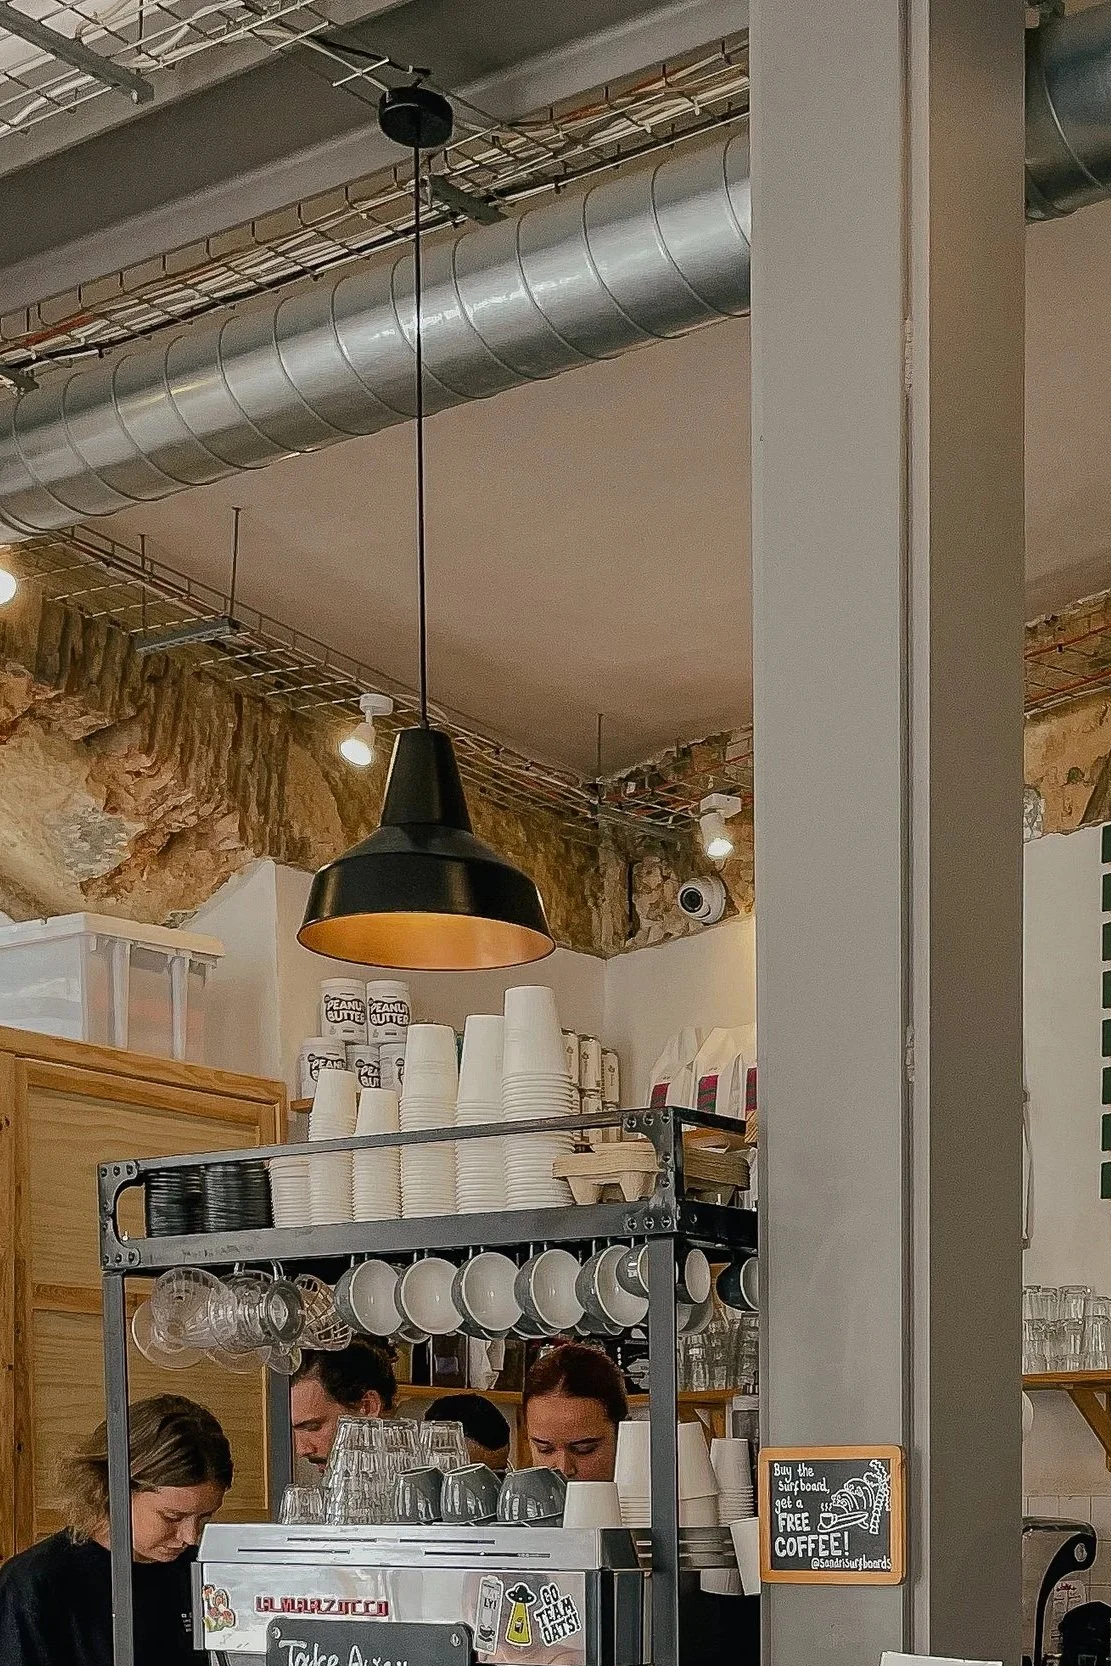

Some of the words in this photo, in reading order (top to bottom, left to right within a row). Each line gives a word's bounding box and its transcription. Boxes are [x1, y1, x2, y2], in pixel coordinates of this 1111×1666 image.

[774, 1463, 792, 1482] Buy
[797, 1463, 815, 1477] the
[775, 1495, 793, 1515] get
[796, 1499, 804, 1508] a
[778, 1512, 811, 1533] FREE
[774, 1531, 850, 1557] COFFEE!
[541, 1584, 559, 1606] GO
[536, 1596, 575, 1628] TEAM
[543, 1613, 581, 1644] OATS!
